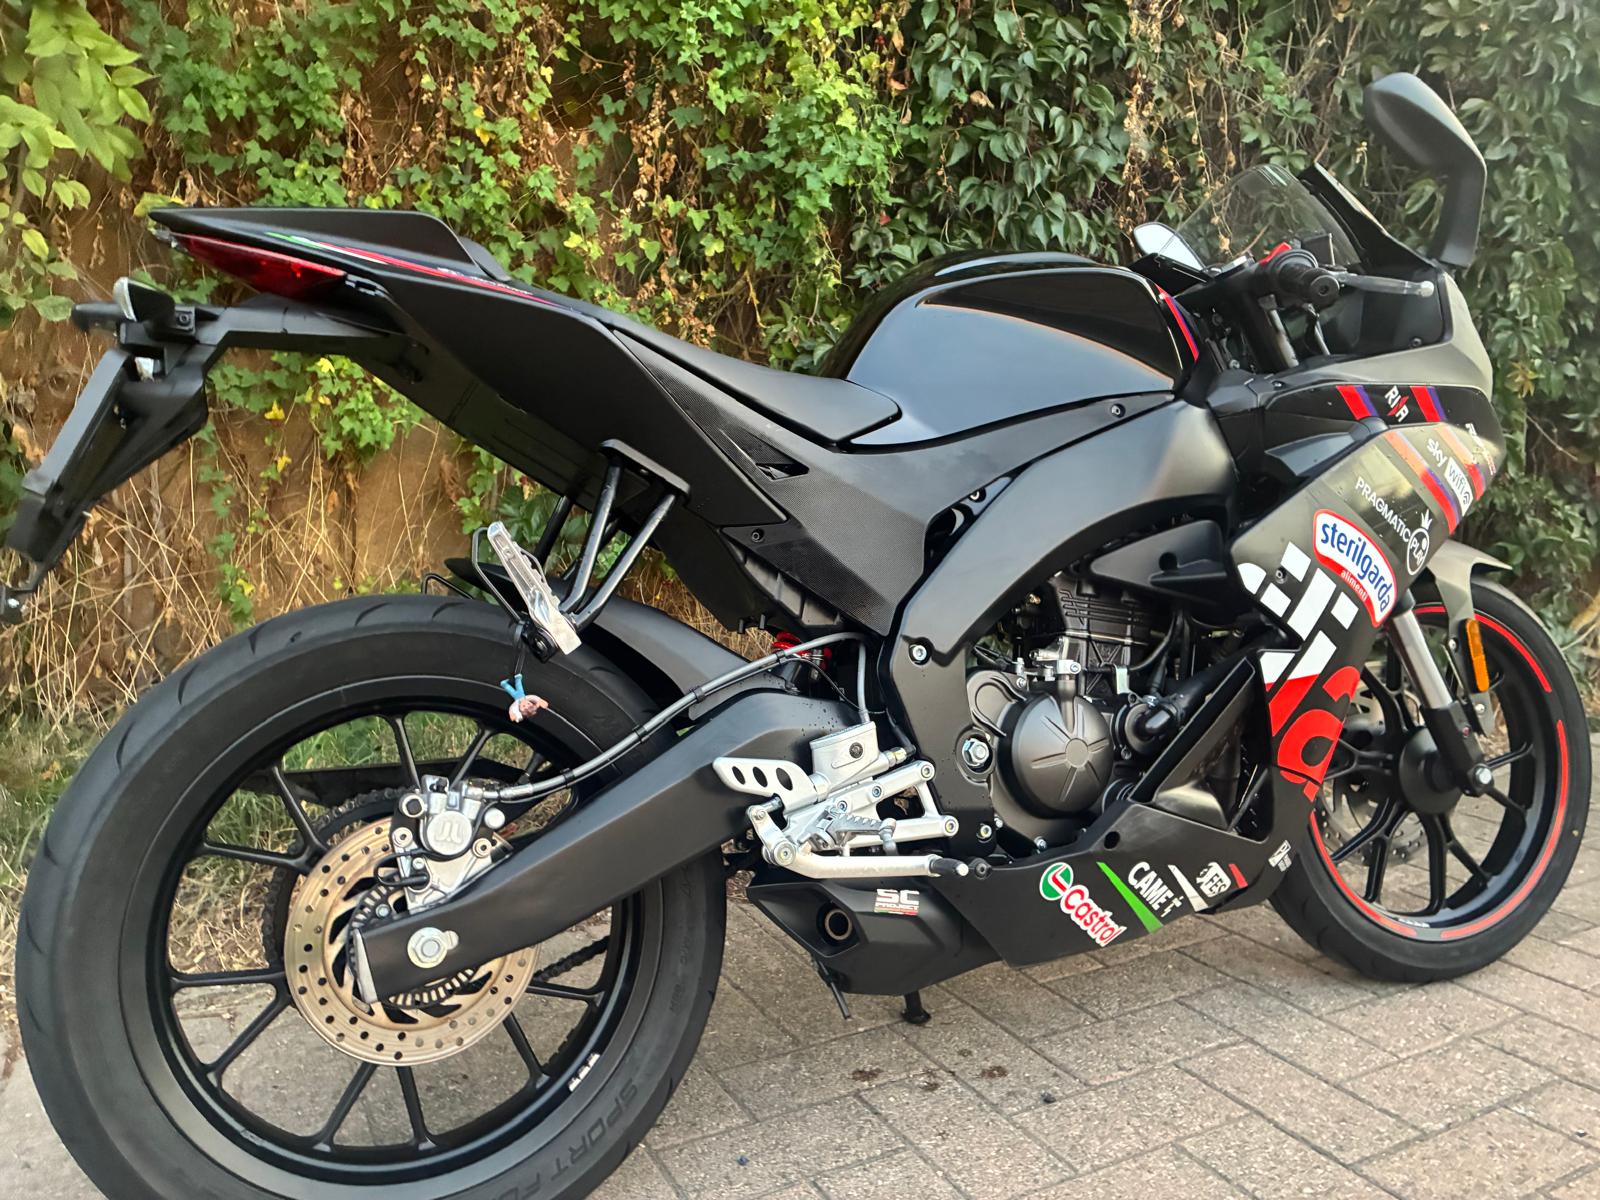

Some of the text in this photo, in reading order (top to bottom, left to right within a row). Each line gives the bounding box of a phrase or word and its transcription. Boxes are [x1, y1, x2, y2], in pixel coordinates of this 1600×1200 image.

[1427, 438, 1448, 468] sky
[1354, 476, 1411, 543] PRAGMATIC
[1320, 522, 1391, 614] sterilgarda
[1340, 568, 1368, 601] alimenti
[876, 888, 920, 905] SC
[1062, 886, 1125, 946] Castrol
[551, 1078, 638, 1183] SPORT
